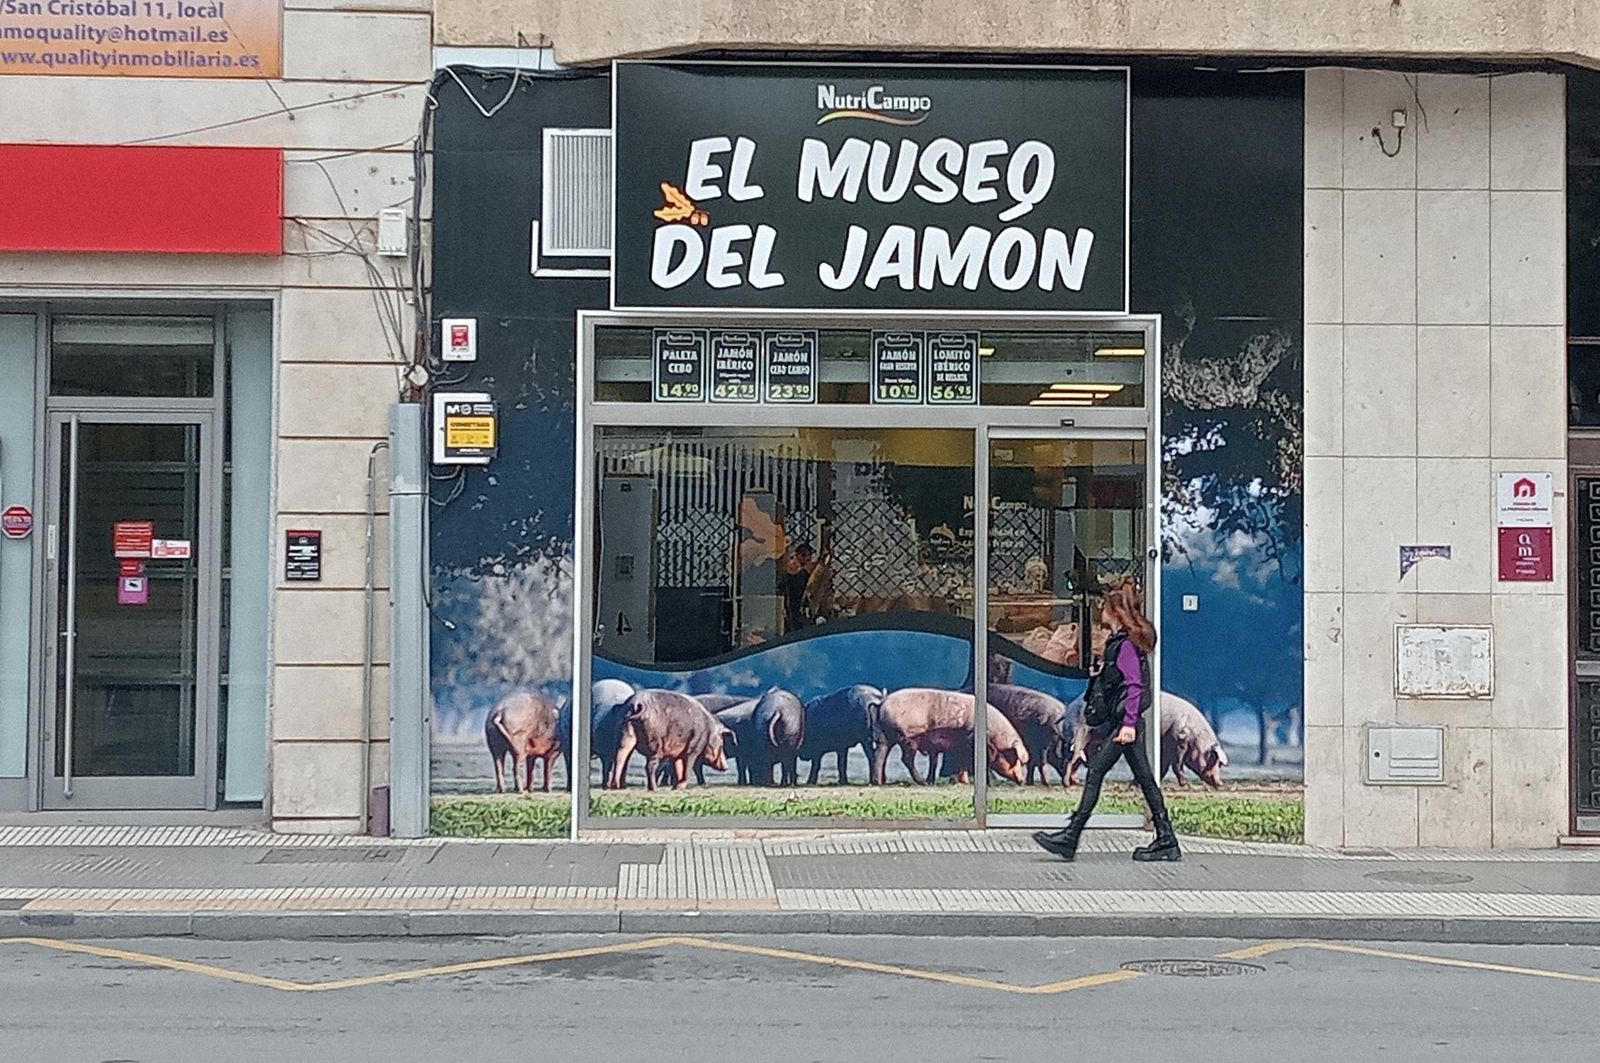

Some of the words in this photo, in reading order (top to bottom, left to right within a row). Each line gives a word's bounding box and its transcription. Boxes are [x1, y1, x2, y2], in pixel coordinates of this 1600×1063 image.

[178, 1, 225, 19] local
[817, 84, 932, 112] NutriCampo
[685, 136, 764, 203] EL
[797, 137, 1056, 206] MUSEO
[650, 223, 785, 290] DEL
[662, 349, 698, 361] PALETA
[717, 345, 754, 359] JAMÓN
[772, 349, 808, 363] JAMÓN
[880, 348, 917, 361] JAMÓN
[933, 349, 971, 360] LOMITO
